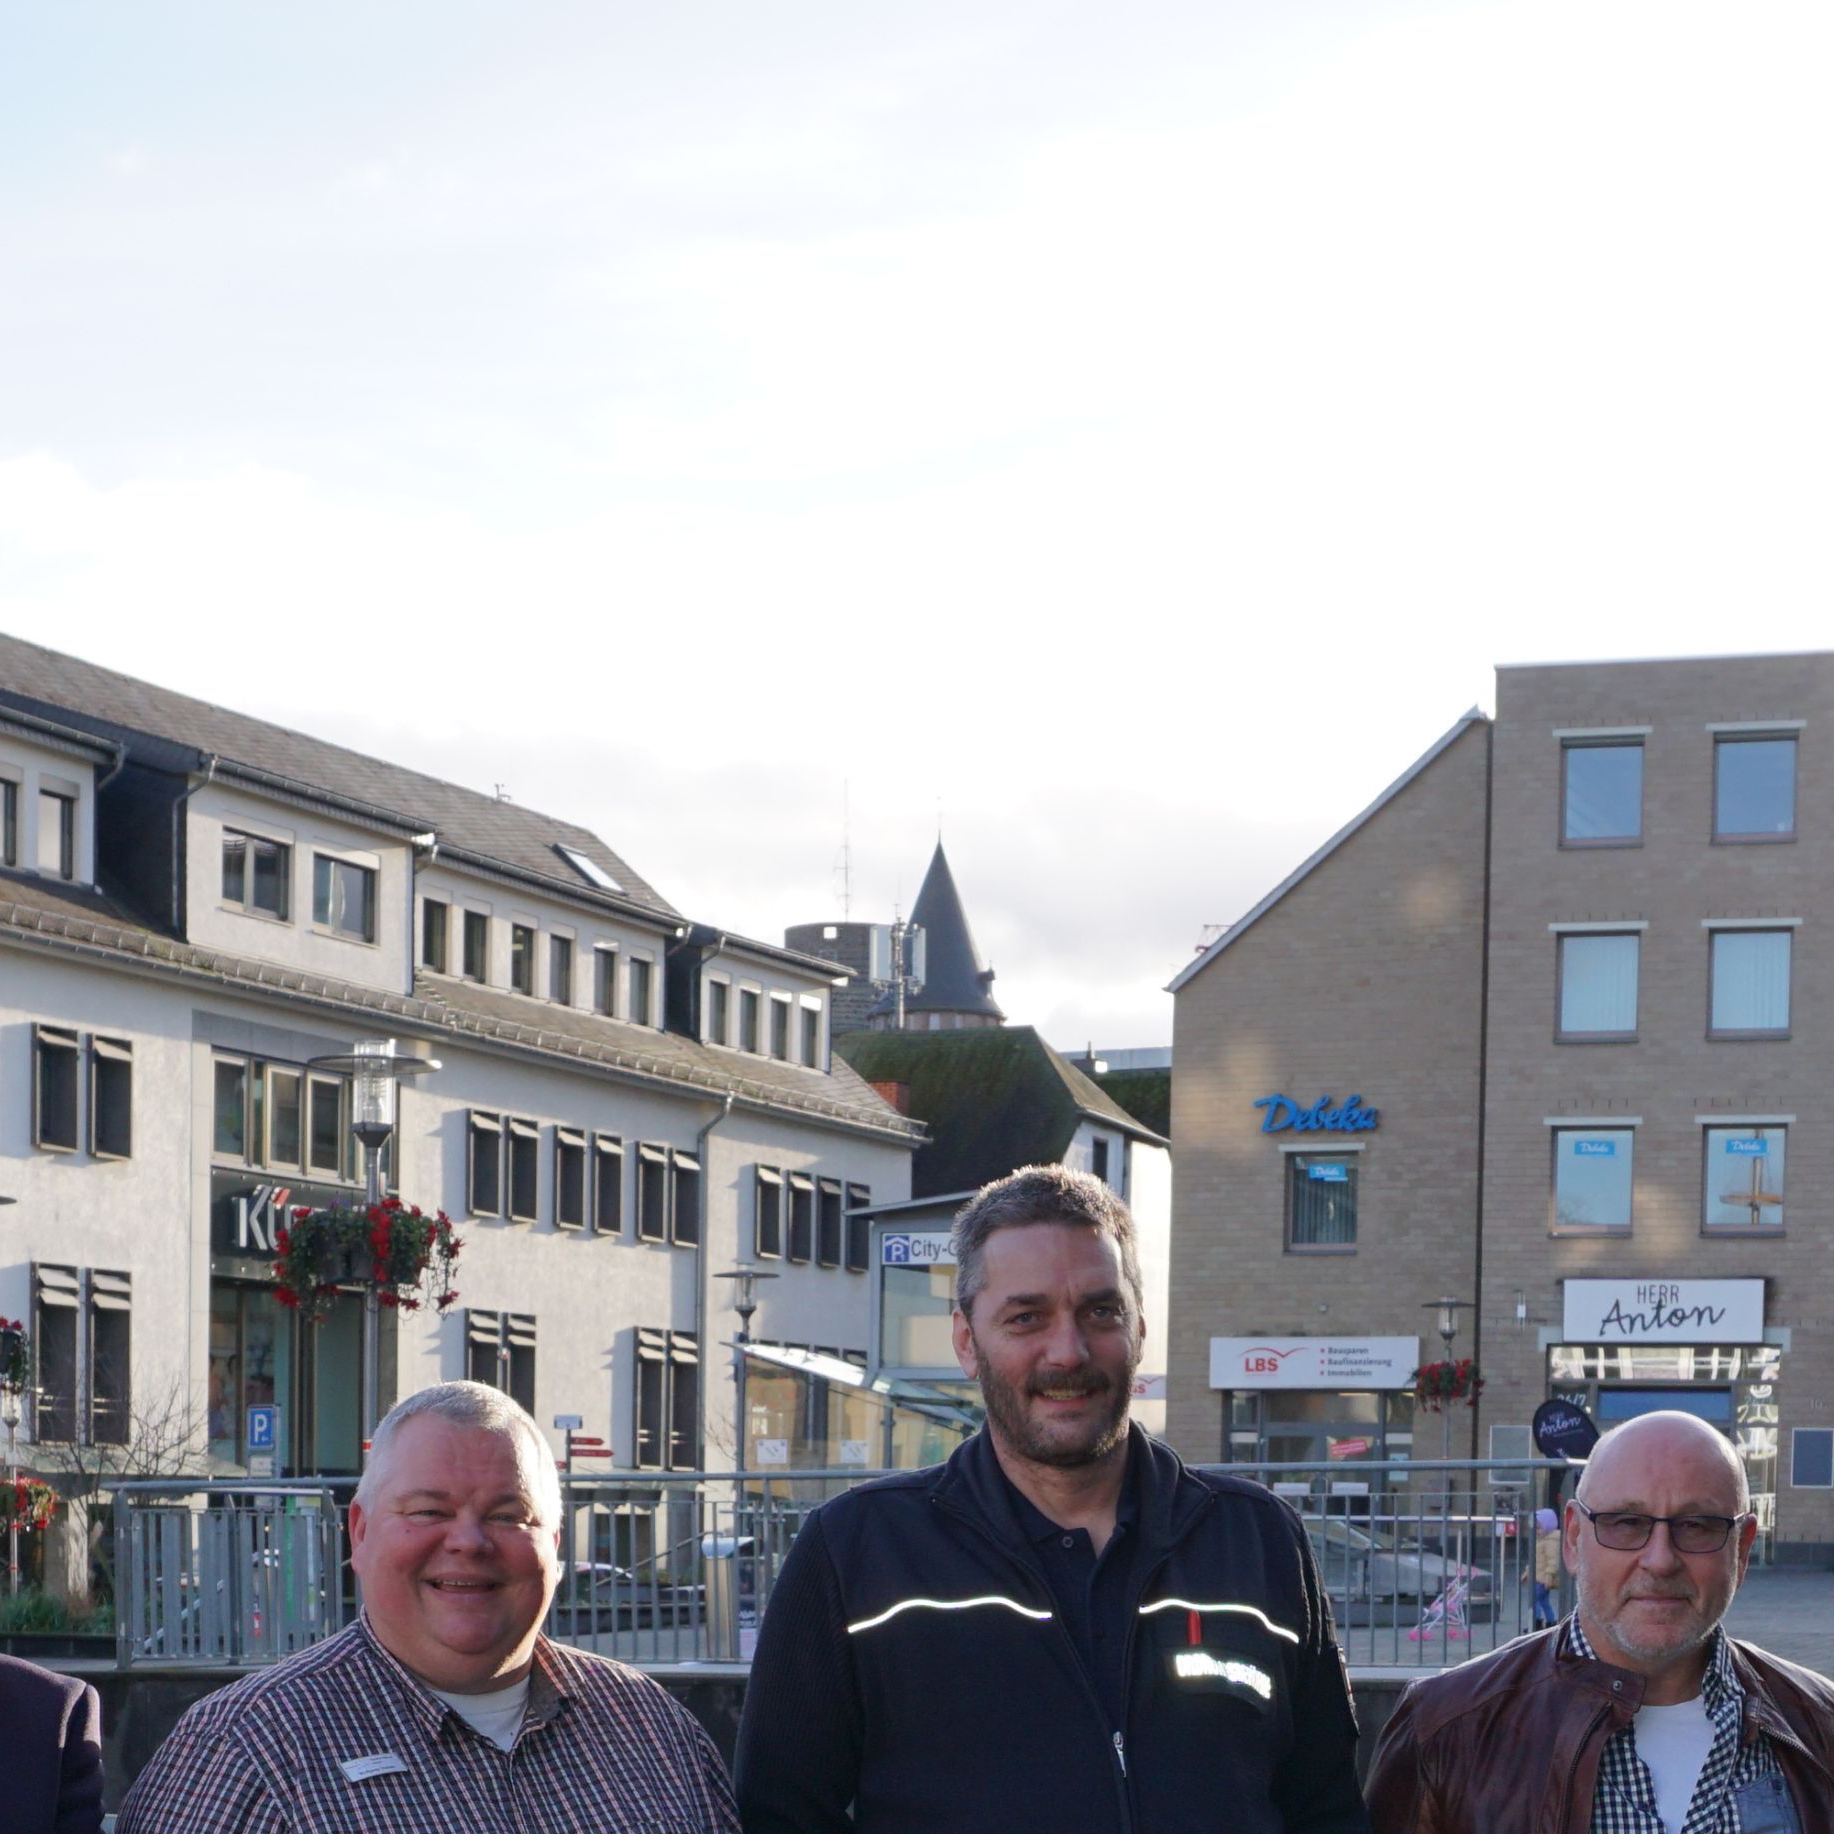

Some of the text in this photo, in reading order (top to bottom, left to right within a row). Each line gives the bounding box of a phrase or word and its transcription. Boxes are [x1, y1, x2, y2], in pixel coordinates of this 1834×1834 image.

[1254, 1093, 1378, 1133] Debeka
[1637, 1284, 1680, 1304] HERR
[1599, 1298, 1725, 1336] Anton
[1245, 1358, 1279, 1372] LBS
[1327, 1358, 1392, 1367] Baufinanzierung
[254, 1413, 267, 1443] P
